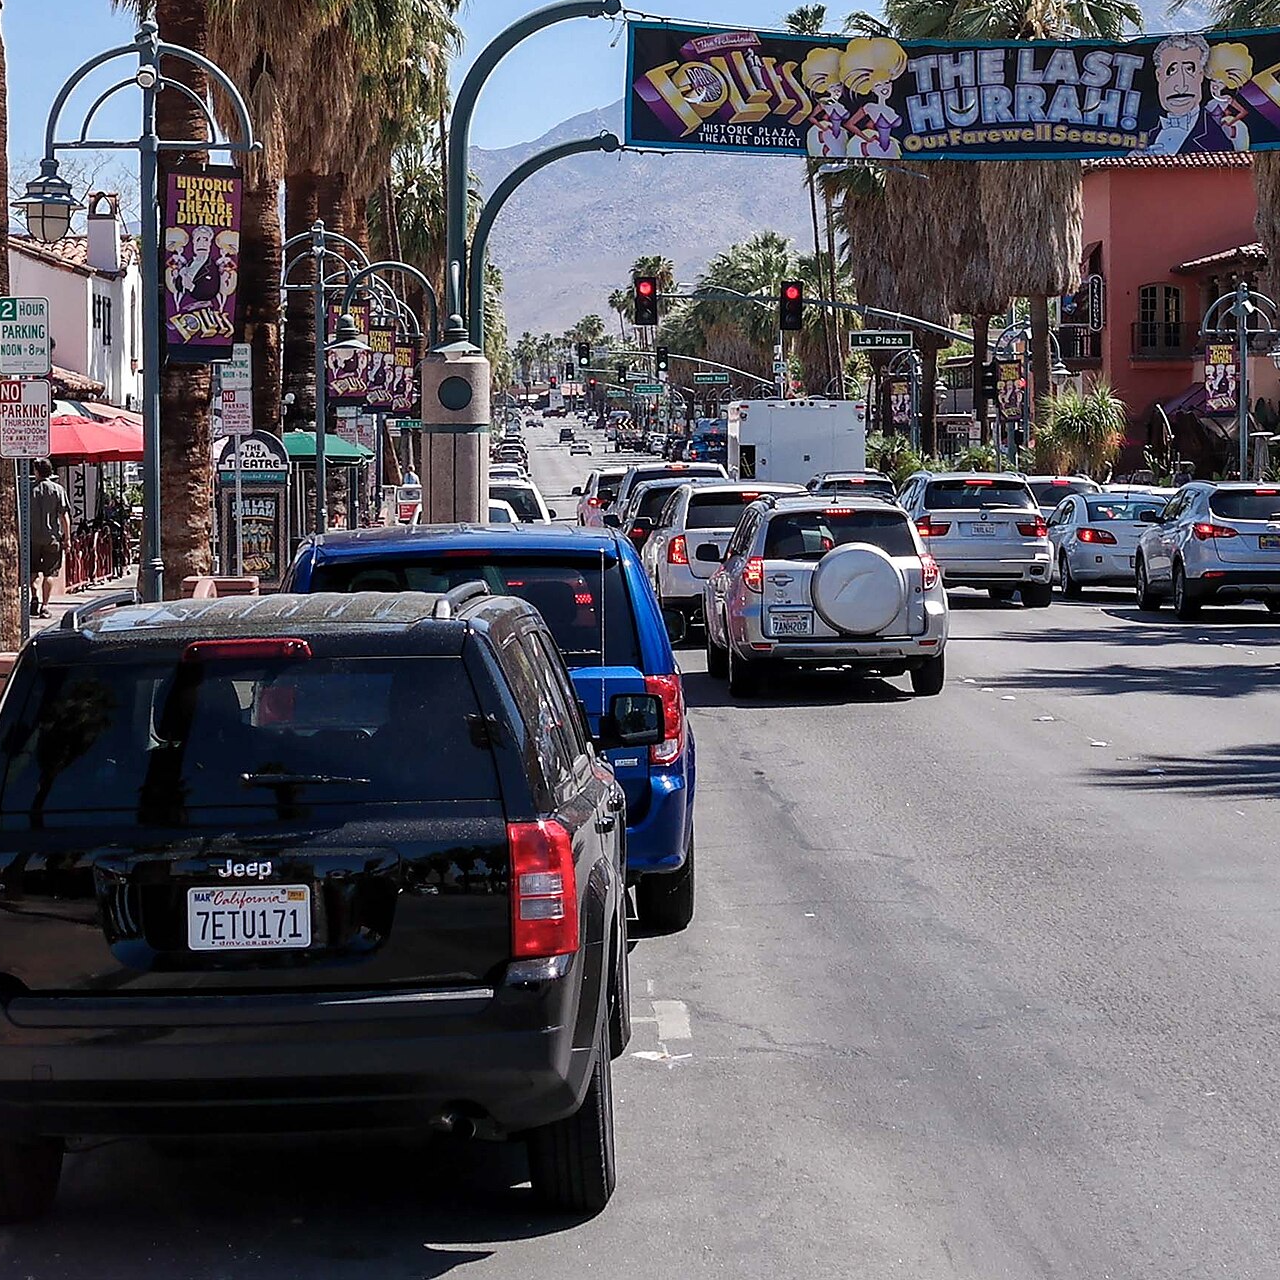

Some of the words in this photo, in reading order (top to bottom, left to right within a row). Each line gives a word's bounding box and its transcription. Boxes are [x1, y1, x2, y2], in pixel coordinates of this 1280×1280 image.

[908, 48, 1005, 92] THE
[1017, 48, 1145, 91] LAST
[906, 84, 1142, 134] HURRAH!
[702, 123, 753, 136] HISTORIC
[758, 126, 796, 138] PLAZA
[698, 132, 748, 145] THEATRE
[753, 135, 802, 148] DISTRICT
[177, 176, 234, 192] HISTORIC
[186, 188, 224, 203] PLAZA
[178, 200, 232, 215] THEATRE
[177, 212, 233, 227] DISTRICT
[1, 301, 14, 318] 2
[19, 303, 45, 317] HOUR
[2, 324, 45, 339] PARKING
[858, 336, 871, 345] La
[875, 336, 903, 345] Plaza
[0, 344, 22, 356] NOON
[0, 384, 20, 401] NO
[222, 392, 235, 402] NO
[1, 404, 47, 418] PARKING
[245, 444, 261, 452] THE
[218, 860, 272, 880] Jeep
[194, 893, 211, 902] MAR
[214, 891, 284, 908] California
[196, 909, 302, 941] 7ETU171
